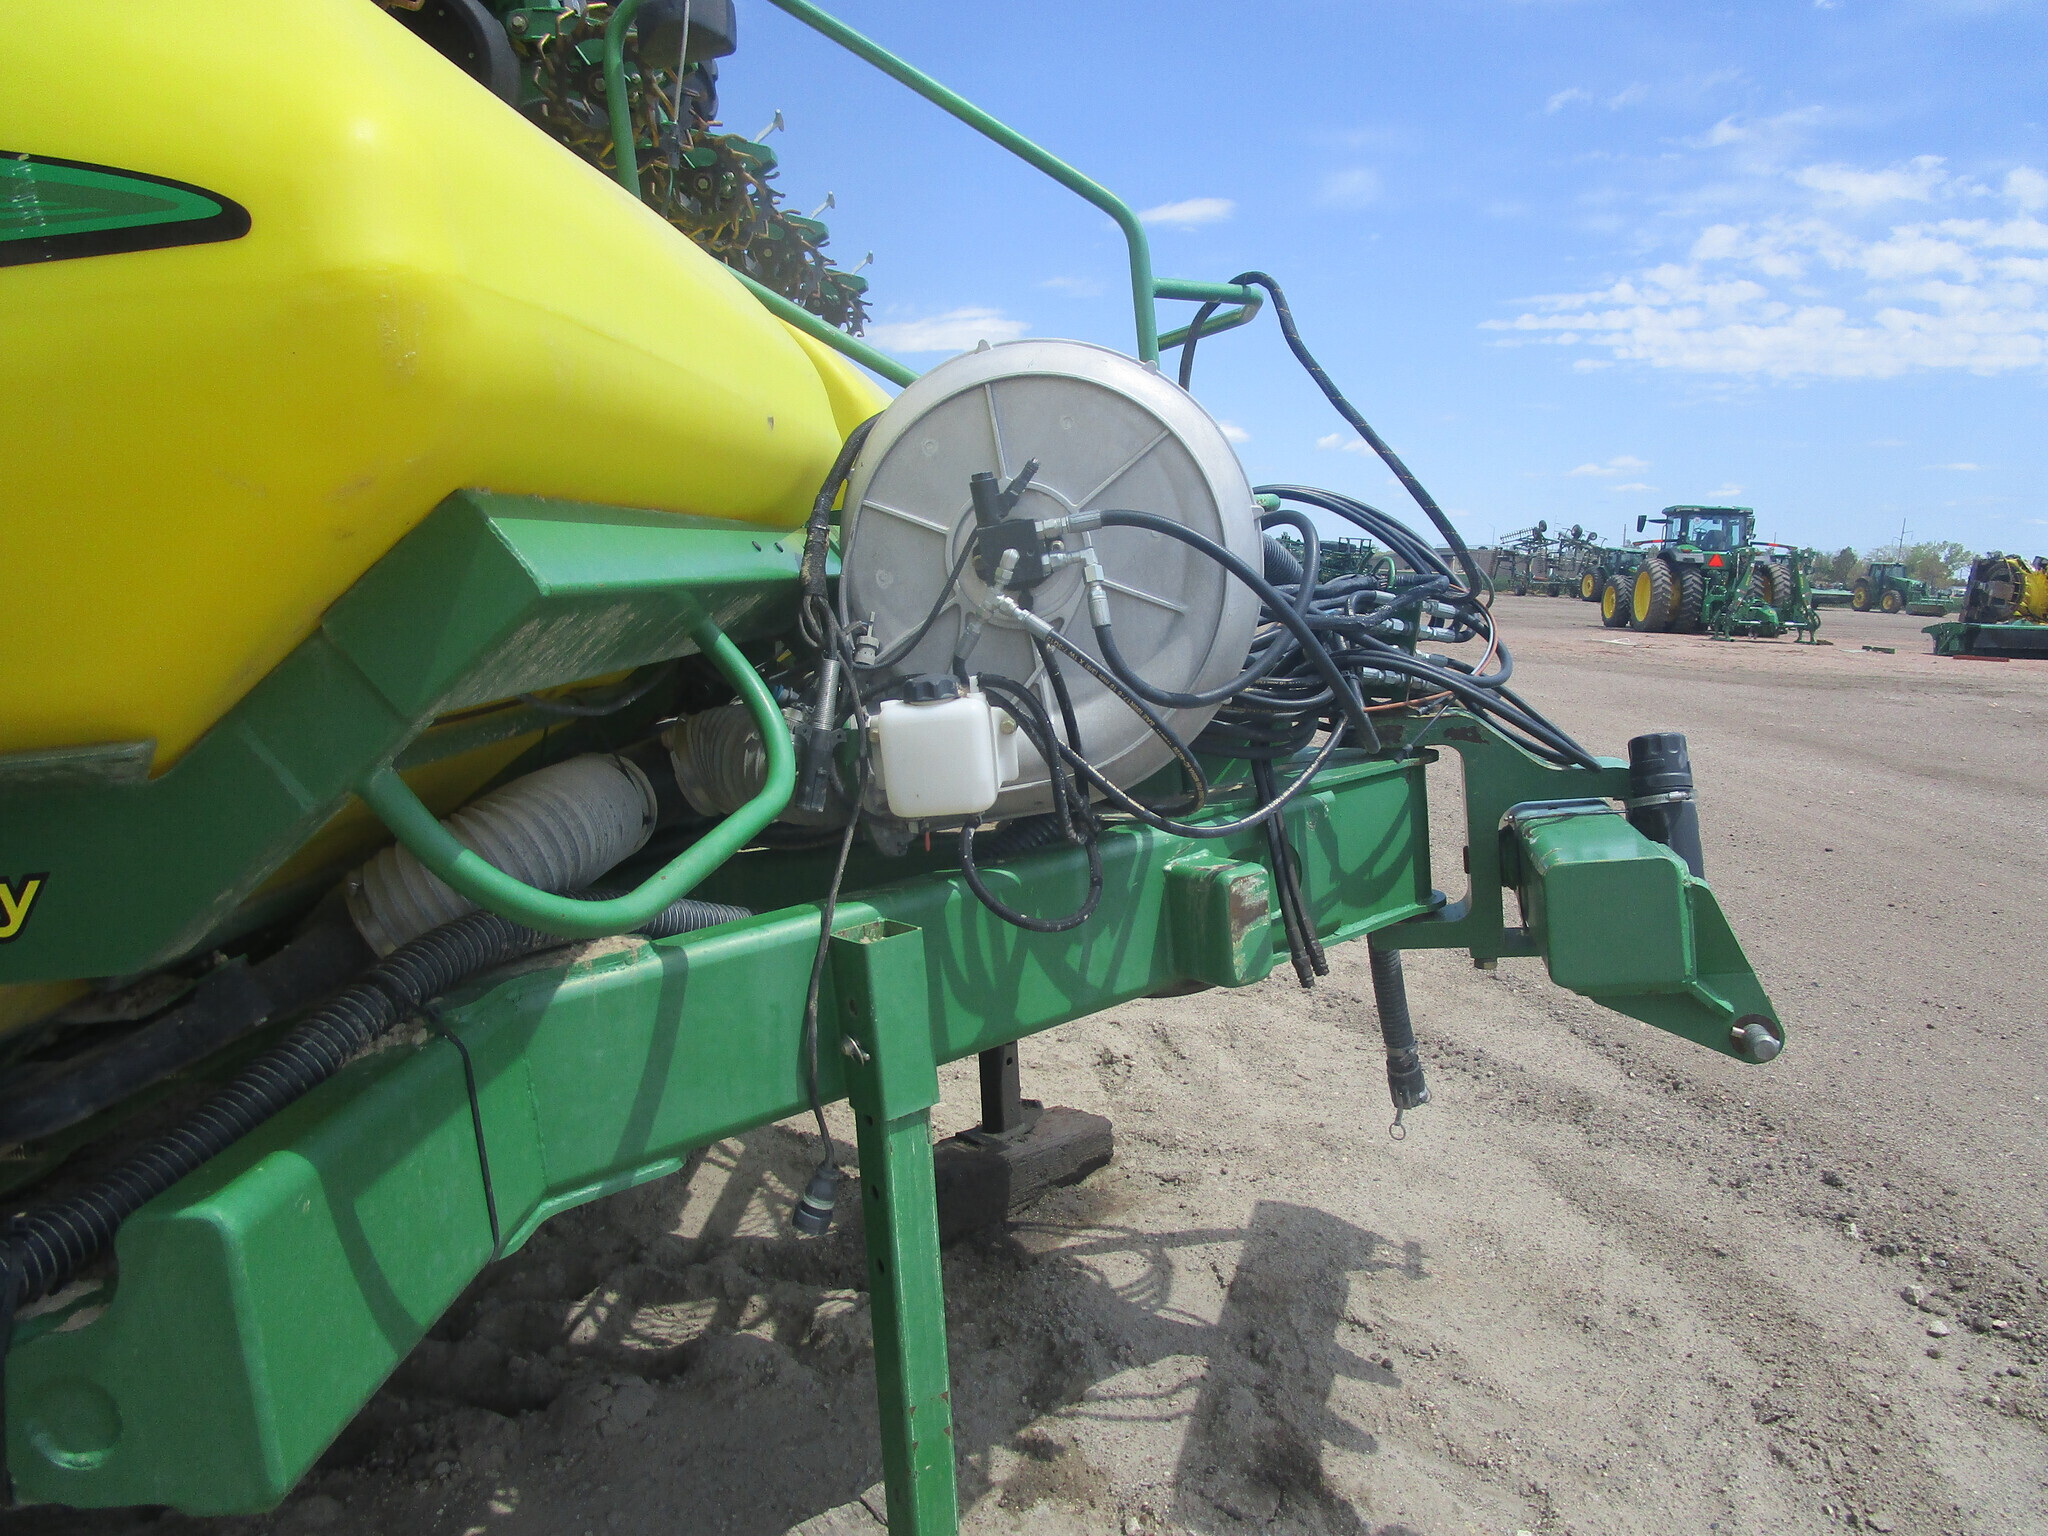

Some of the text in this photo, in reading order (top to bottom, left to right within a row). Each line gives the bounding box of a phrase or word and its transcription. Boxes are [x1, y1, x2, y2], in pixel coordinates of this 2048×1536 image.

[1097, 673, 1110, 684] mm
[1109, 683, 1117, 691] 10
[1142, 714, 1155, 726] SAE
